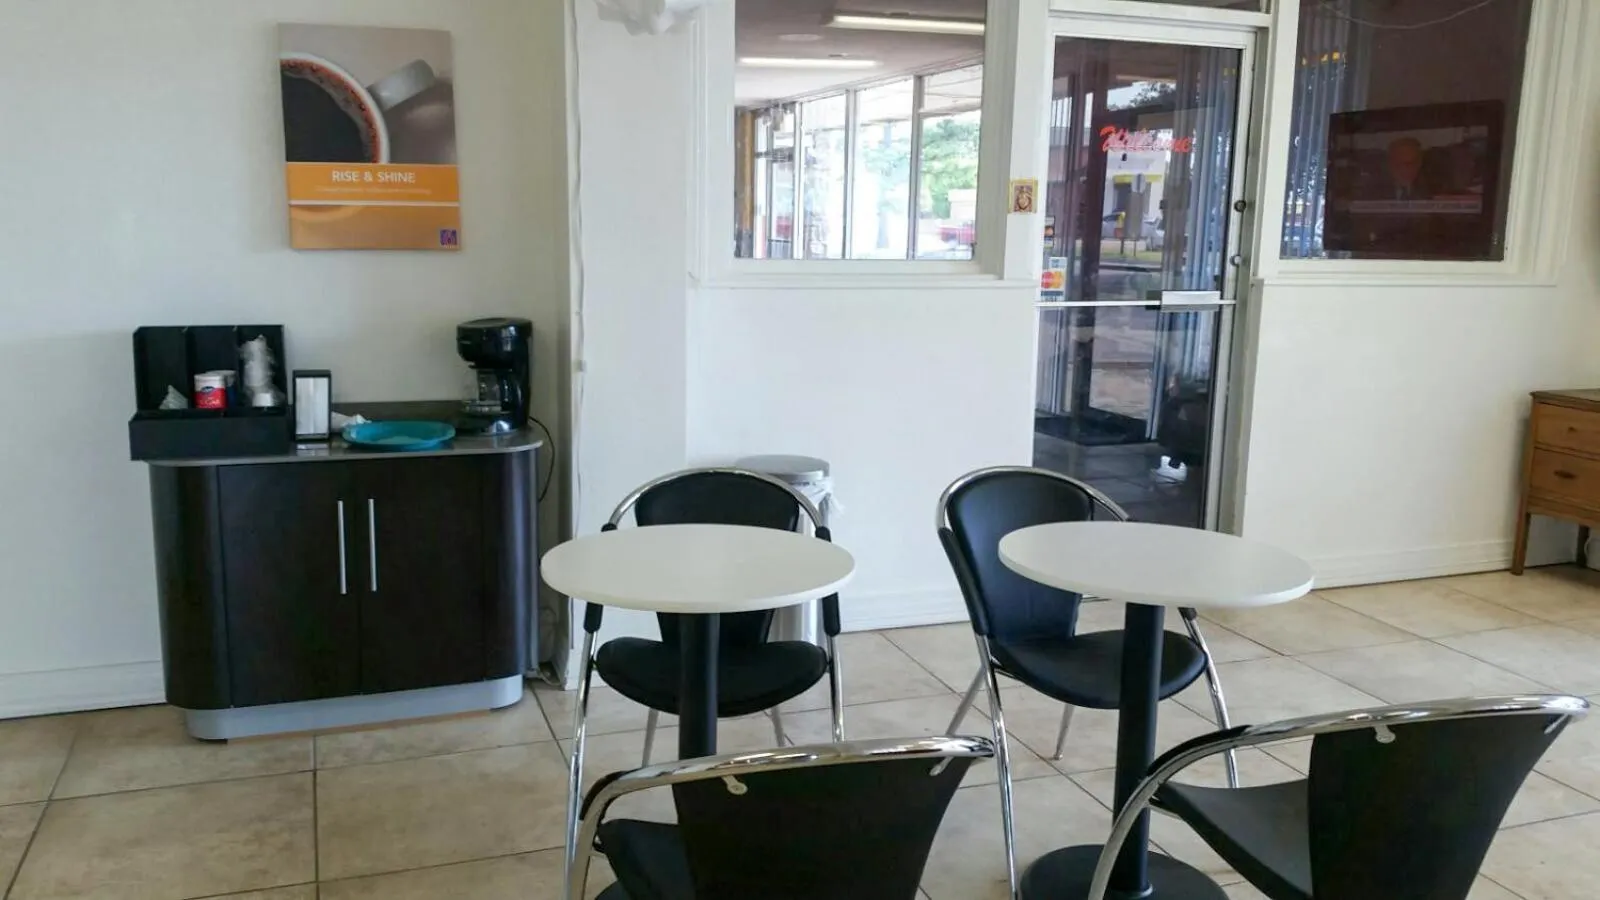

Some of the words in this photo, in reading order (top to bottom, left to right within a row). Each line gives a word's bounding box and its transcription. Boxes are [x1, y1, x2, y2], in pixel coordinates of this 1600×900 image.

[331, 170, 361, 183] RISE
[363, 171, 373, 183] &
[377, 171, 416, 184] SHINE
